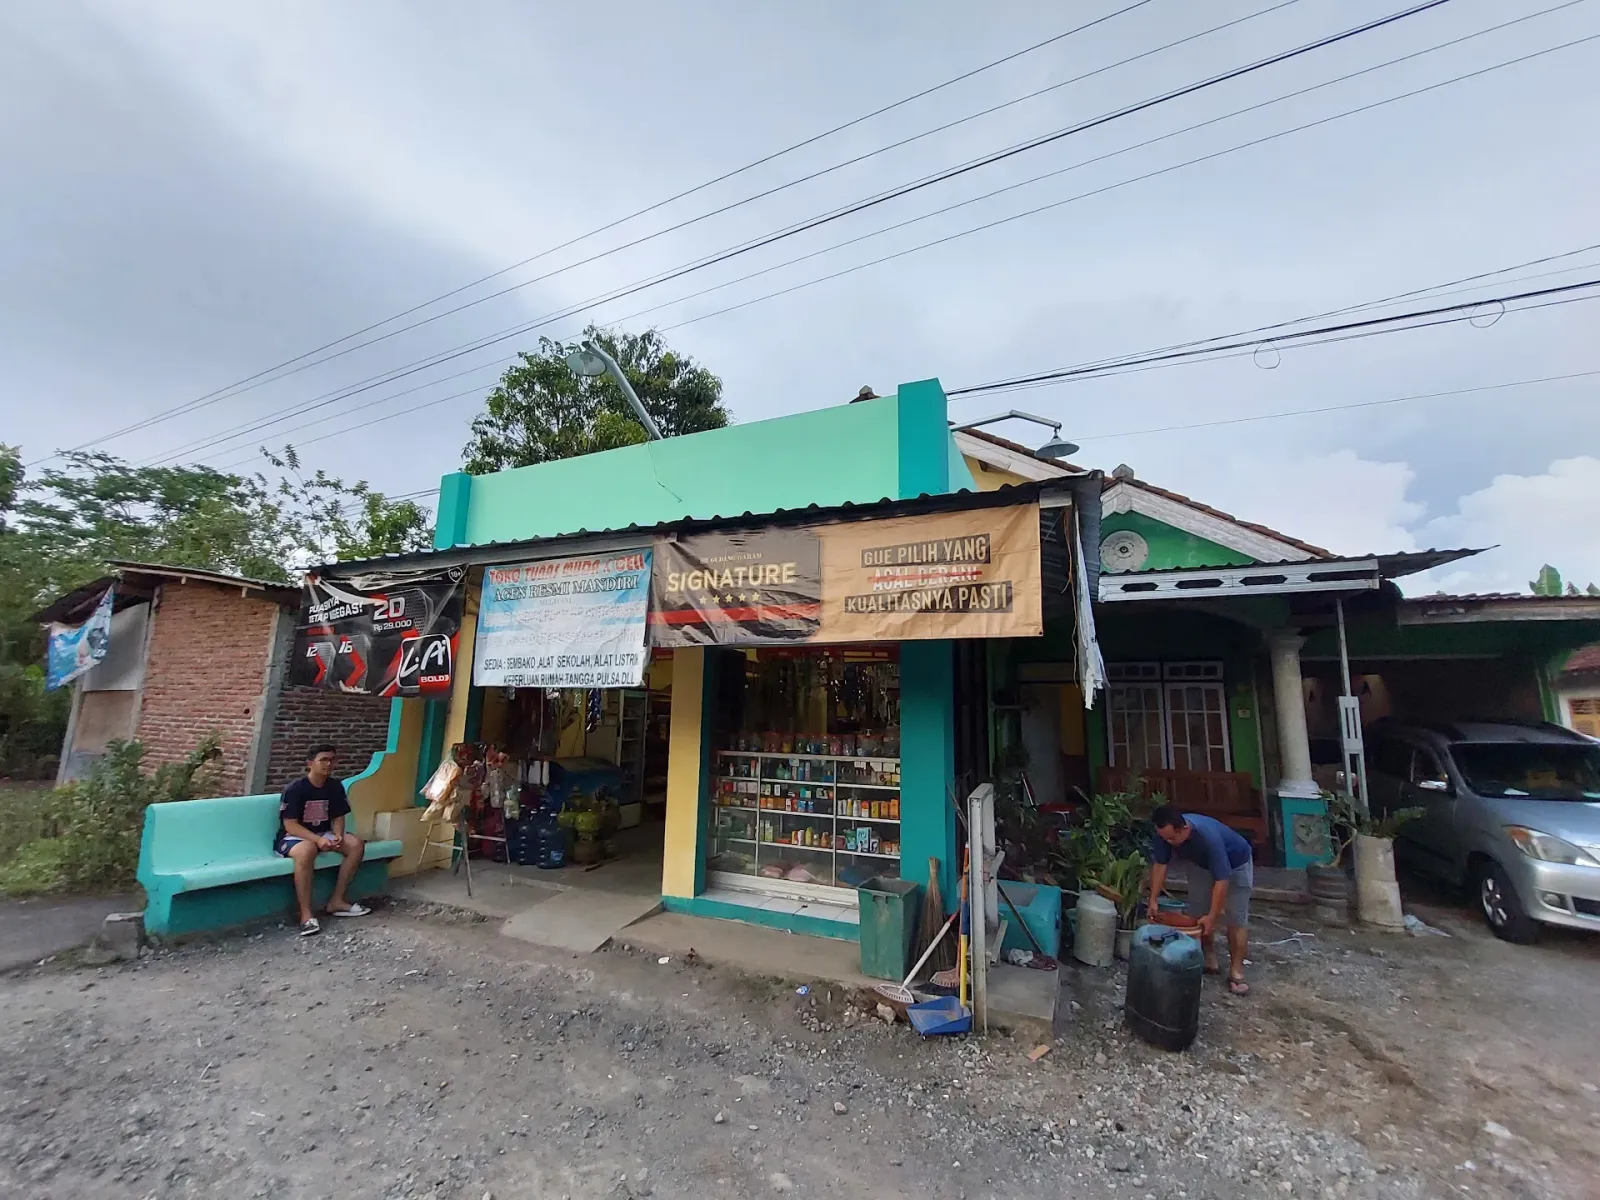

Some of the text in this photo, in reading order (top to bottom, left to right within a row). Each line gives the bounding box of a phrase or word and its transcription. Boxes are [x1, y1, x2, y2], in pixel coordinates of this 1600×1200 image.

[864, 536, 986, 566] GUE PILIH YANG
[493, 575, 639, 602] AGEN RESMI MANDIRI
[667, 562, 797, 593] SIGNATURE
[373, 597, 406, 620] 20
[847, 584, 1007, 612] KUALITASNYA PASTI
[306, 646, 318, 657] 12
[338, 641, 353, 654] 16
[594, 654, 613, 667] ALAT
